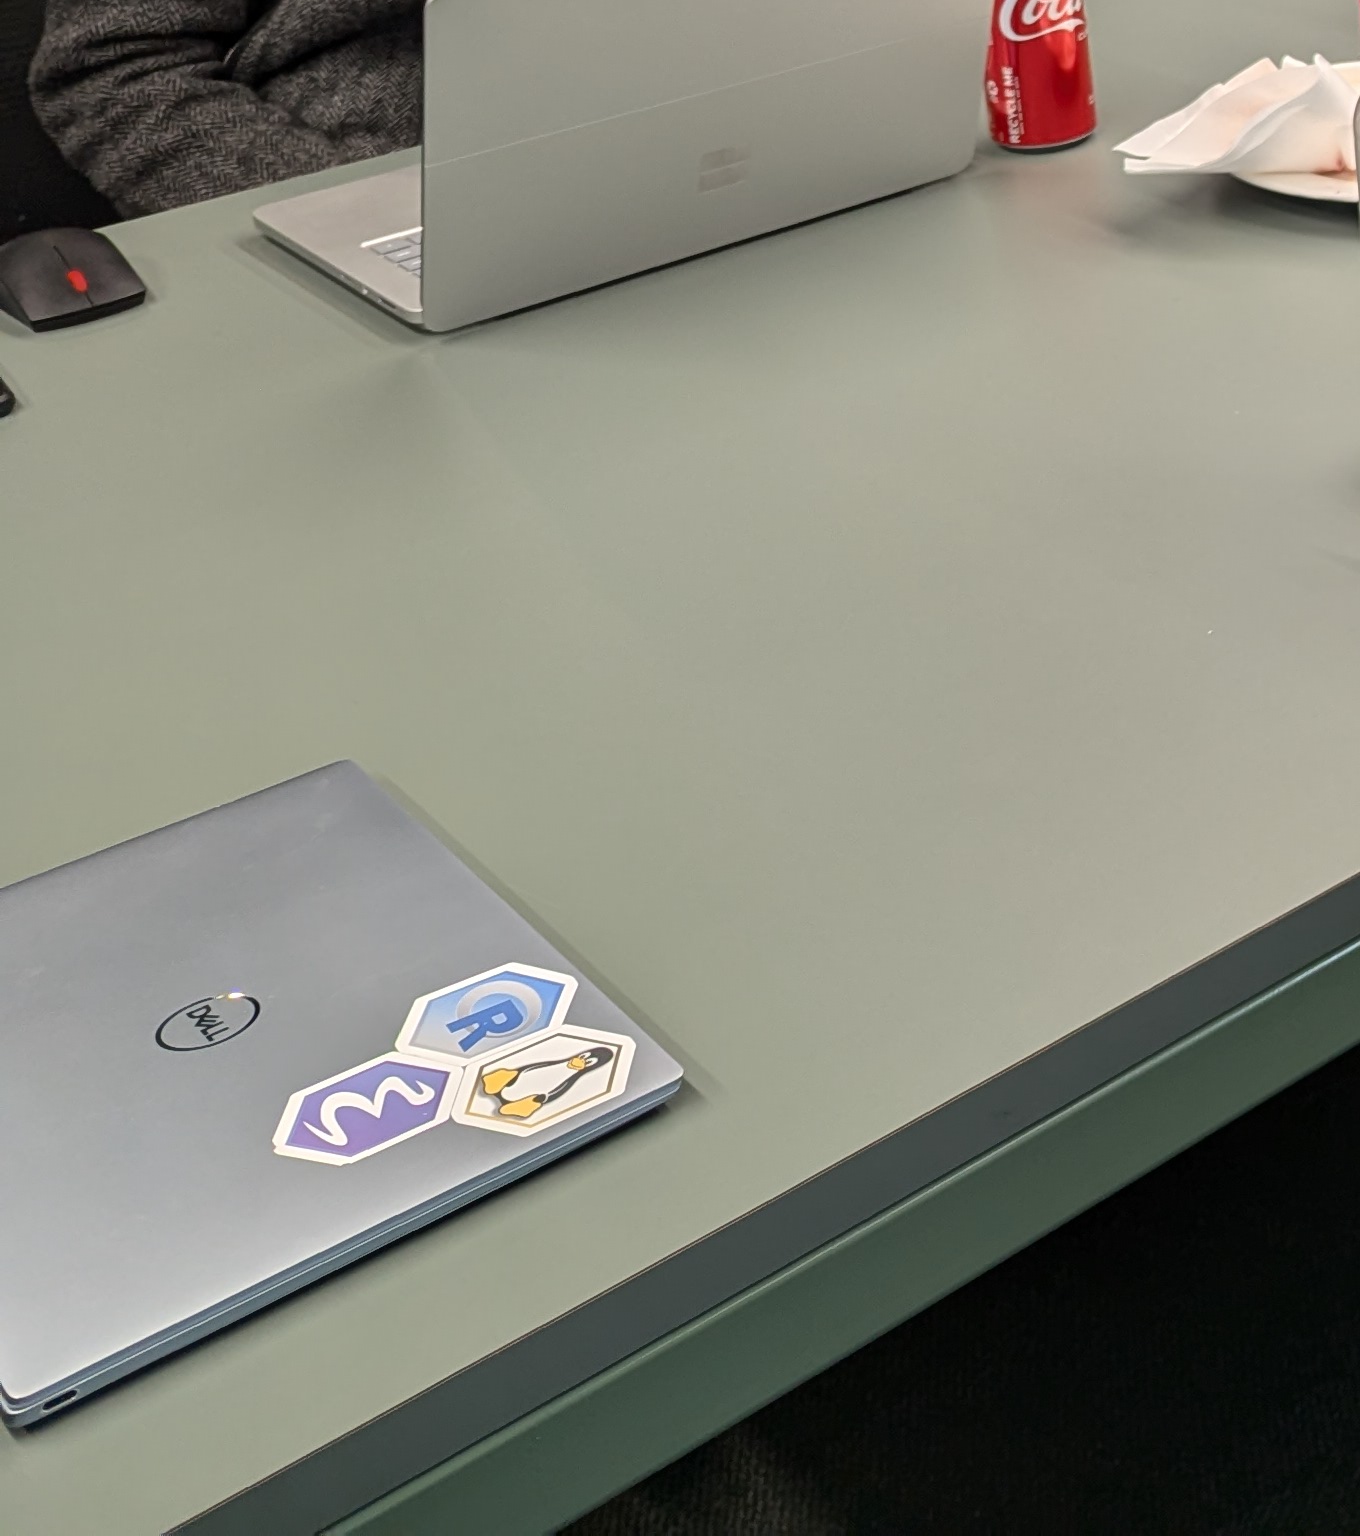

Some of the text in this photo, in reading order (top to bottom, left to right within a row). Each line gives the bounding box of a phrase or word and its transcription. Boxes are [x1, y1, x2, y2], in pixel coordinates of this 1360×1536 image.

[1004, 85, 1021, 144] RECYCLE
[185, 1003, 229, 1044] DELL
[445, 999, 523, 1053] R
